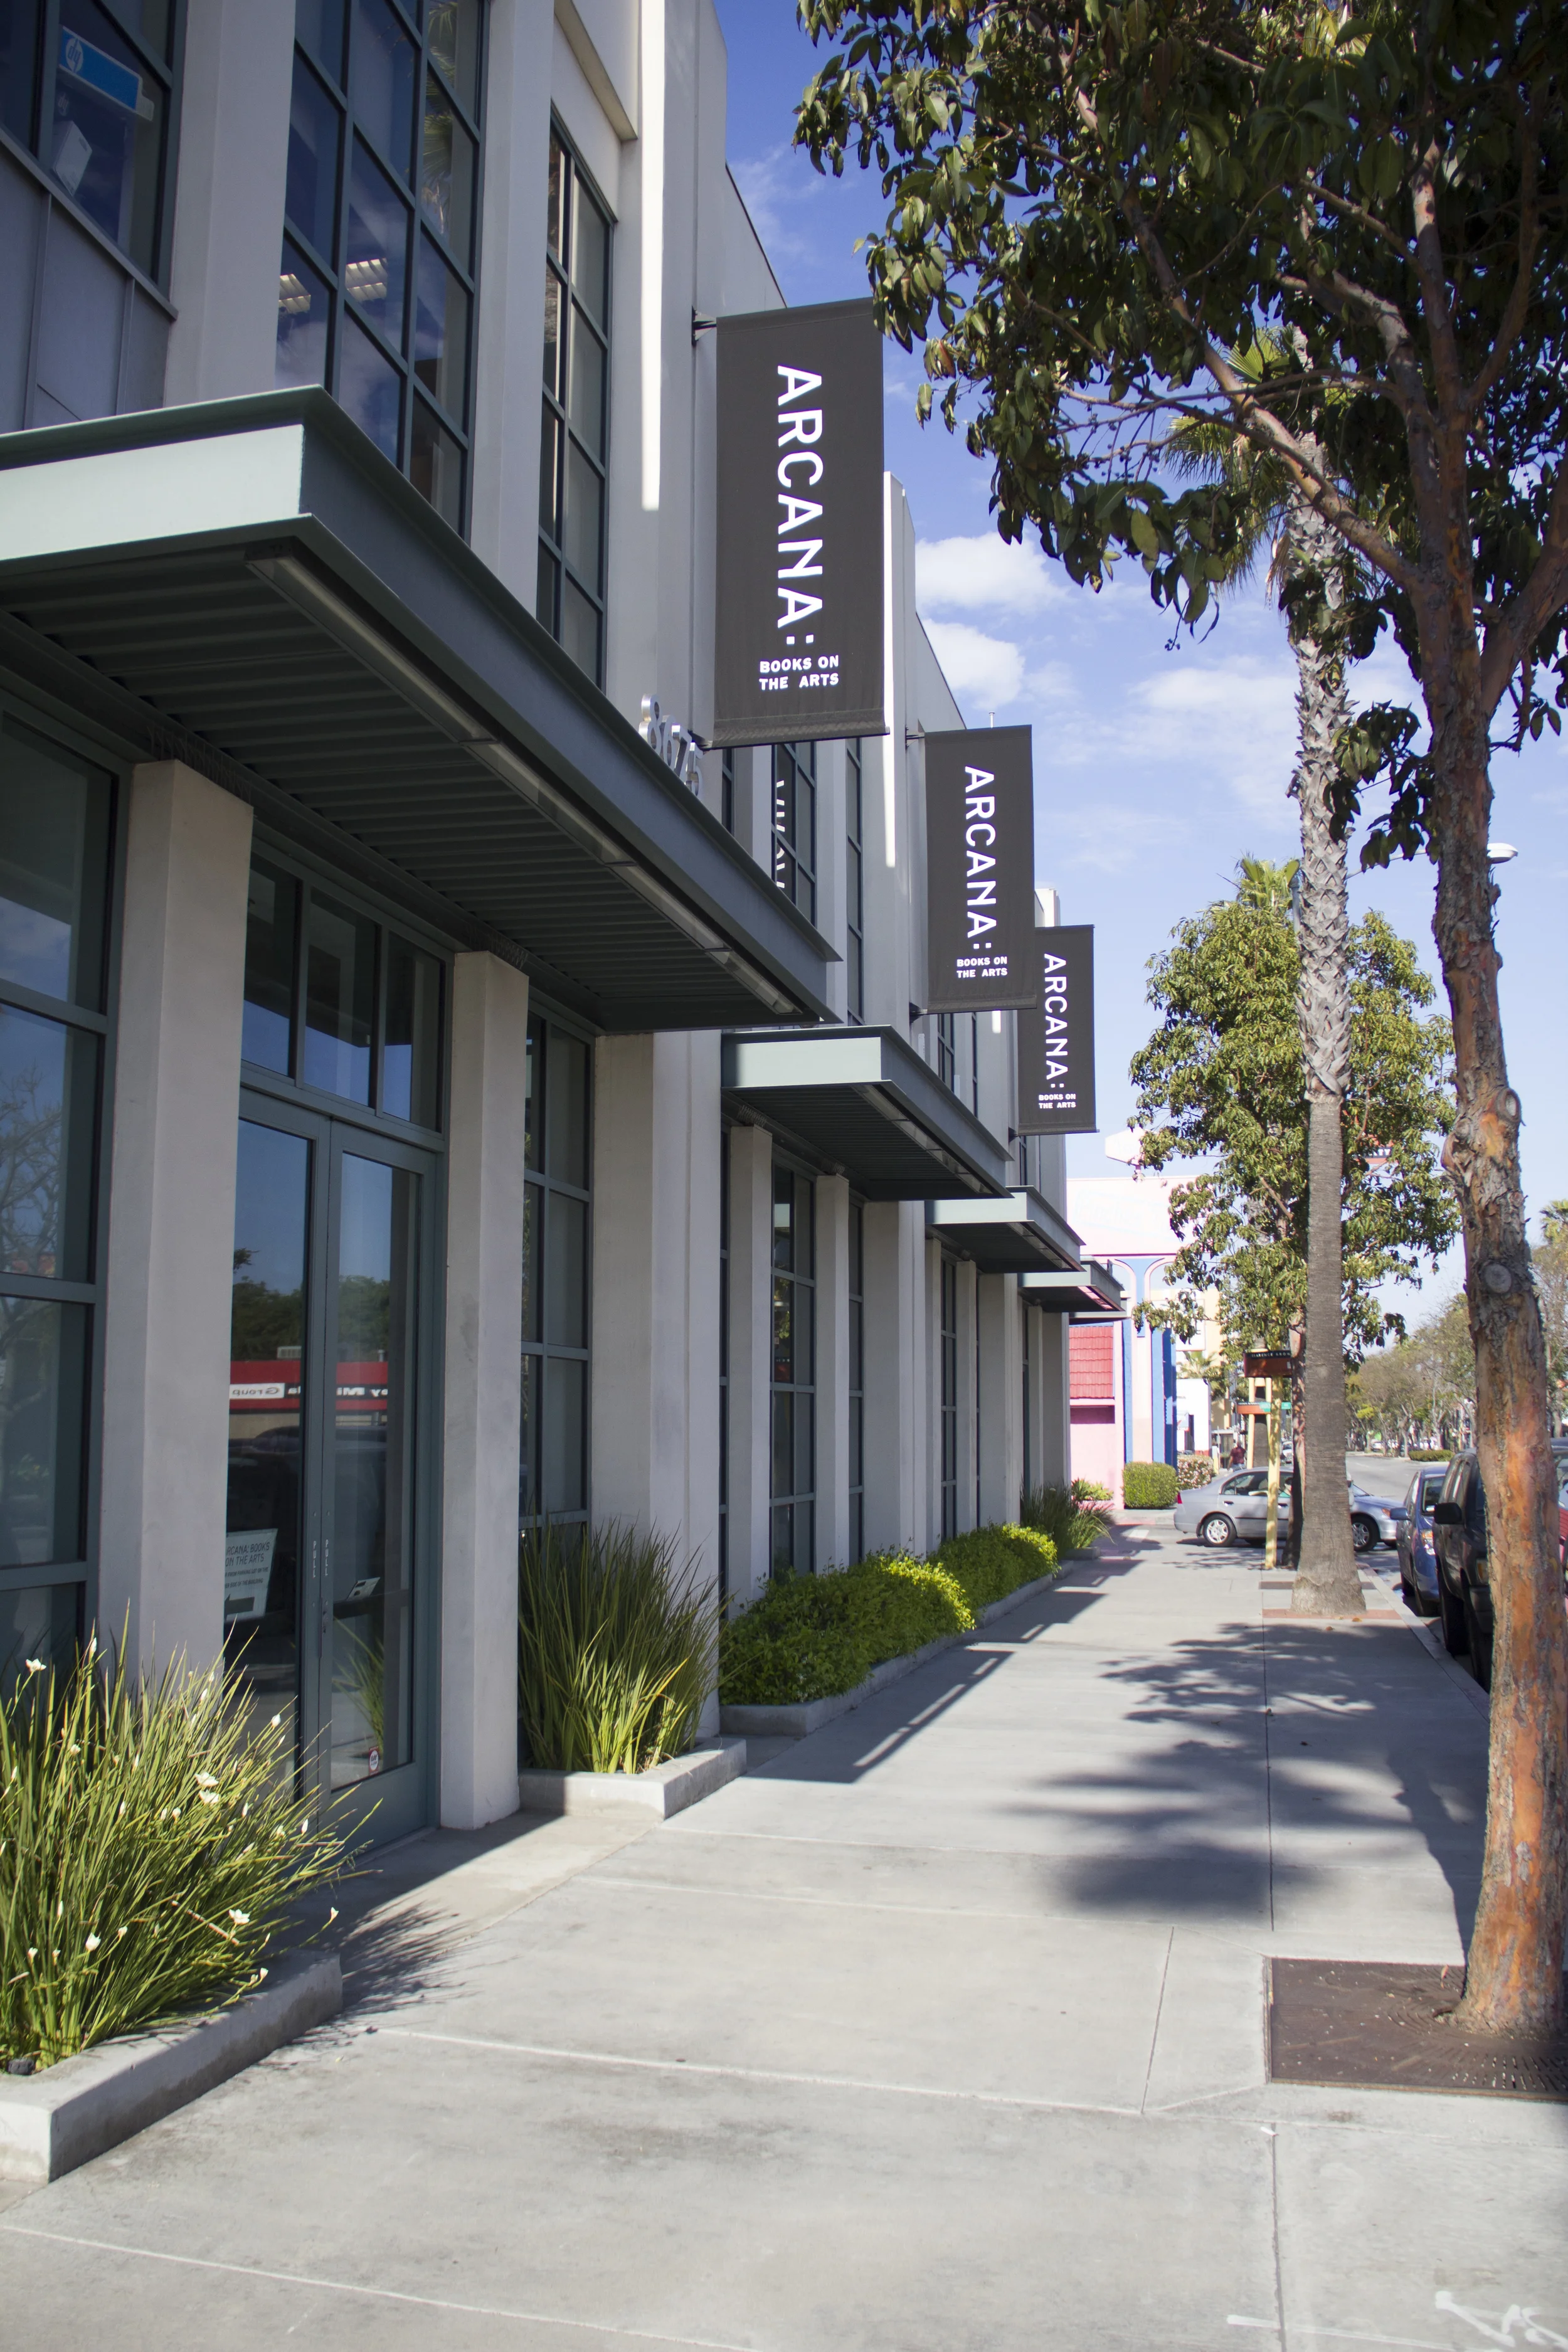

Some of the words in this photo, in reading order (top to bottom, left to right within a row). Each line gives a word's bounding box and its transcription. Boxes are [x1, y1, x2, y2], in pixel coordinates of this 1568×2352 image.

[777, 365, 824, 645] ARCANA:
[760, 657, 812, 674] BOOKS
[817, 655, 839, 669] ON
[759, 675, 788, 691] THE
[798, 672, 839, 687] ARTS
[965, 766, 997, 950] ARCANA:
[956, 956, 991, 967] BOOKS
[993, 956, 1008, 965] ON
[956, 969, 976, 978] THE
[981, 967, 1008, 977] ARTS
[1044, 953, 1068, 1088] ARCANA:
[226, 1545, 249, 1555] RCANA:
[250, 1542, 270, 1553] BOOKS
[225, 1557, 235, 1567] ON
[236, 1555, 247, 1565] THE
[248, 1553, 265, 1564] ARTS
